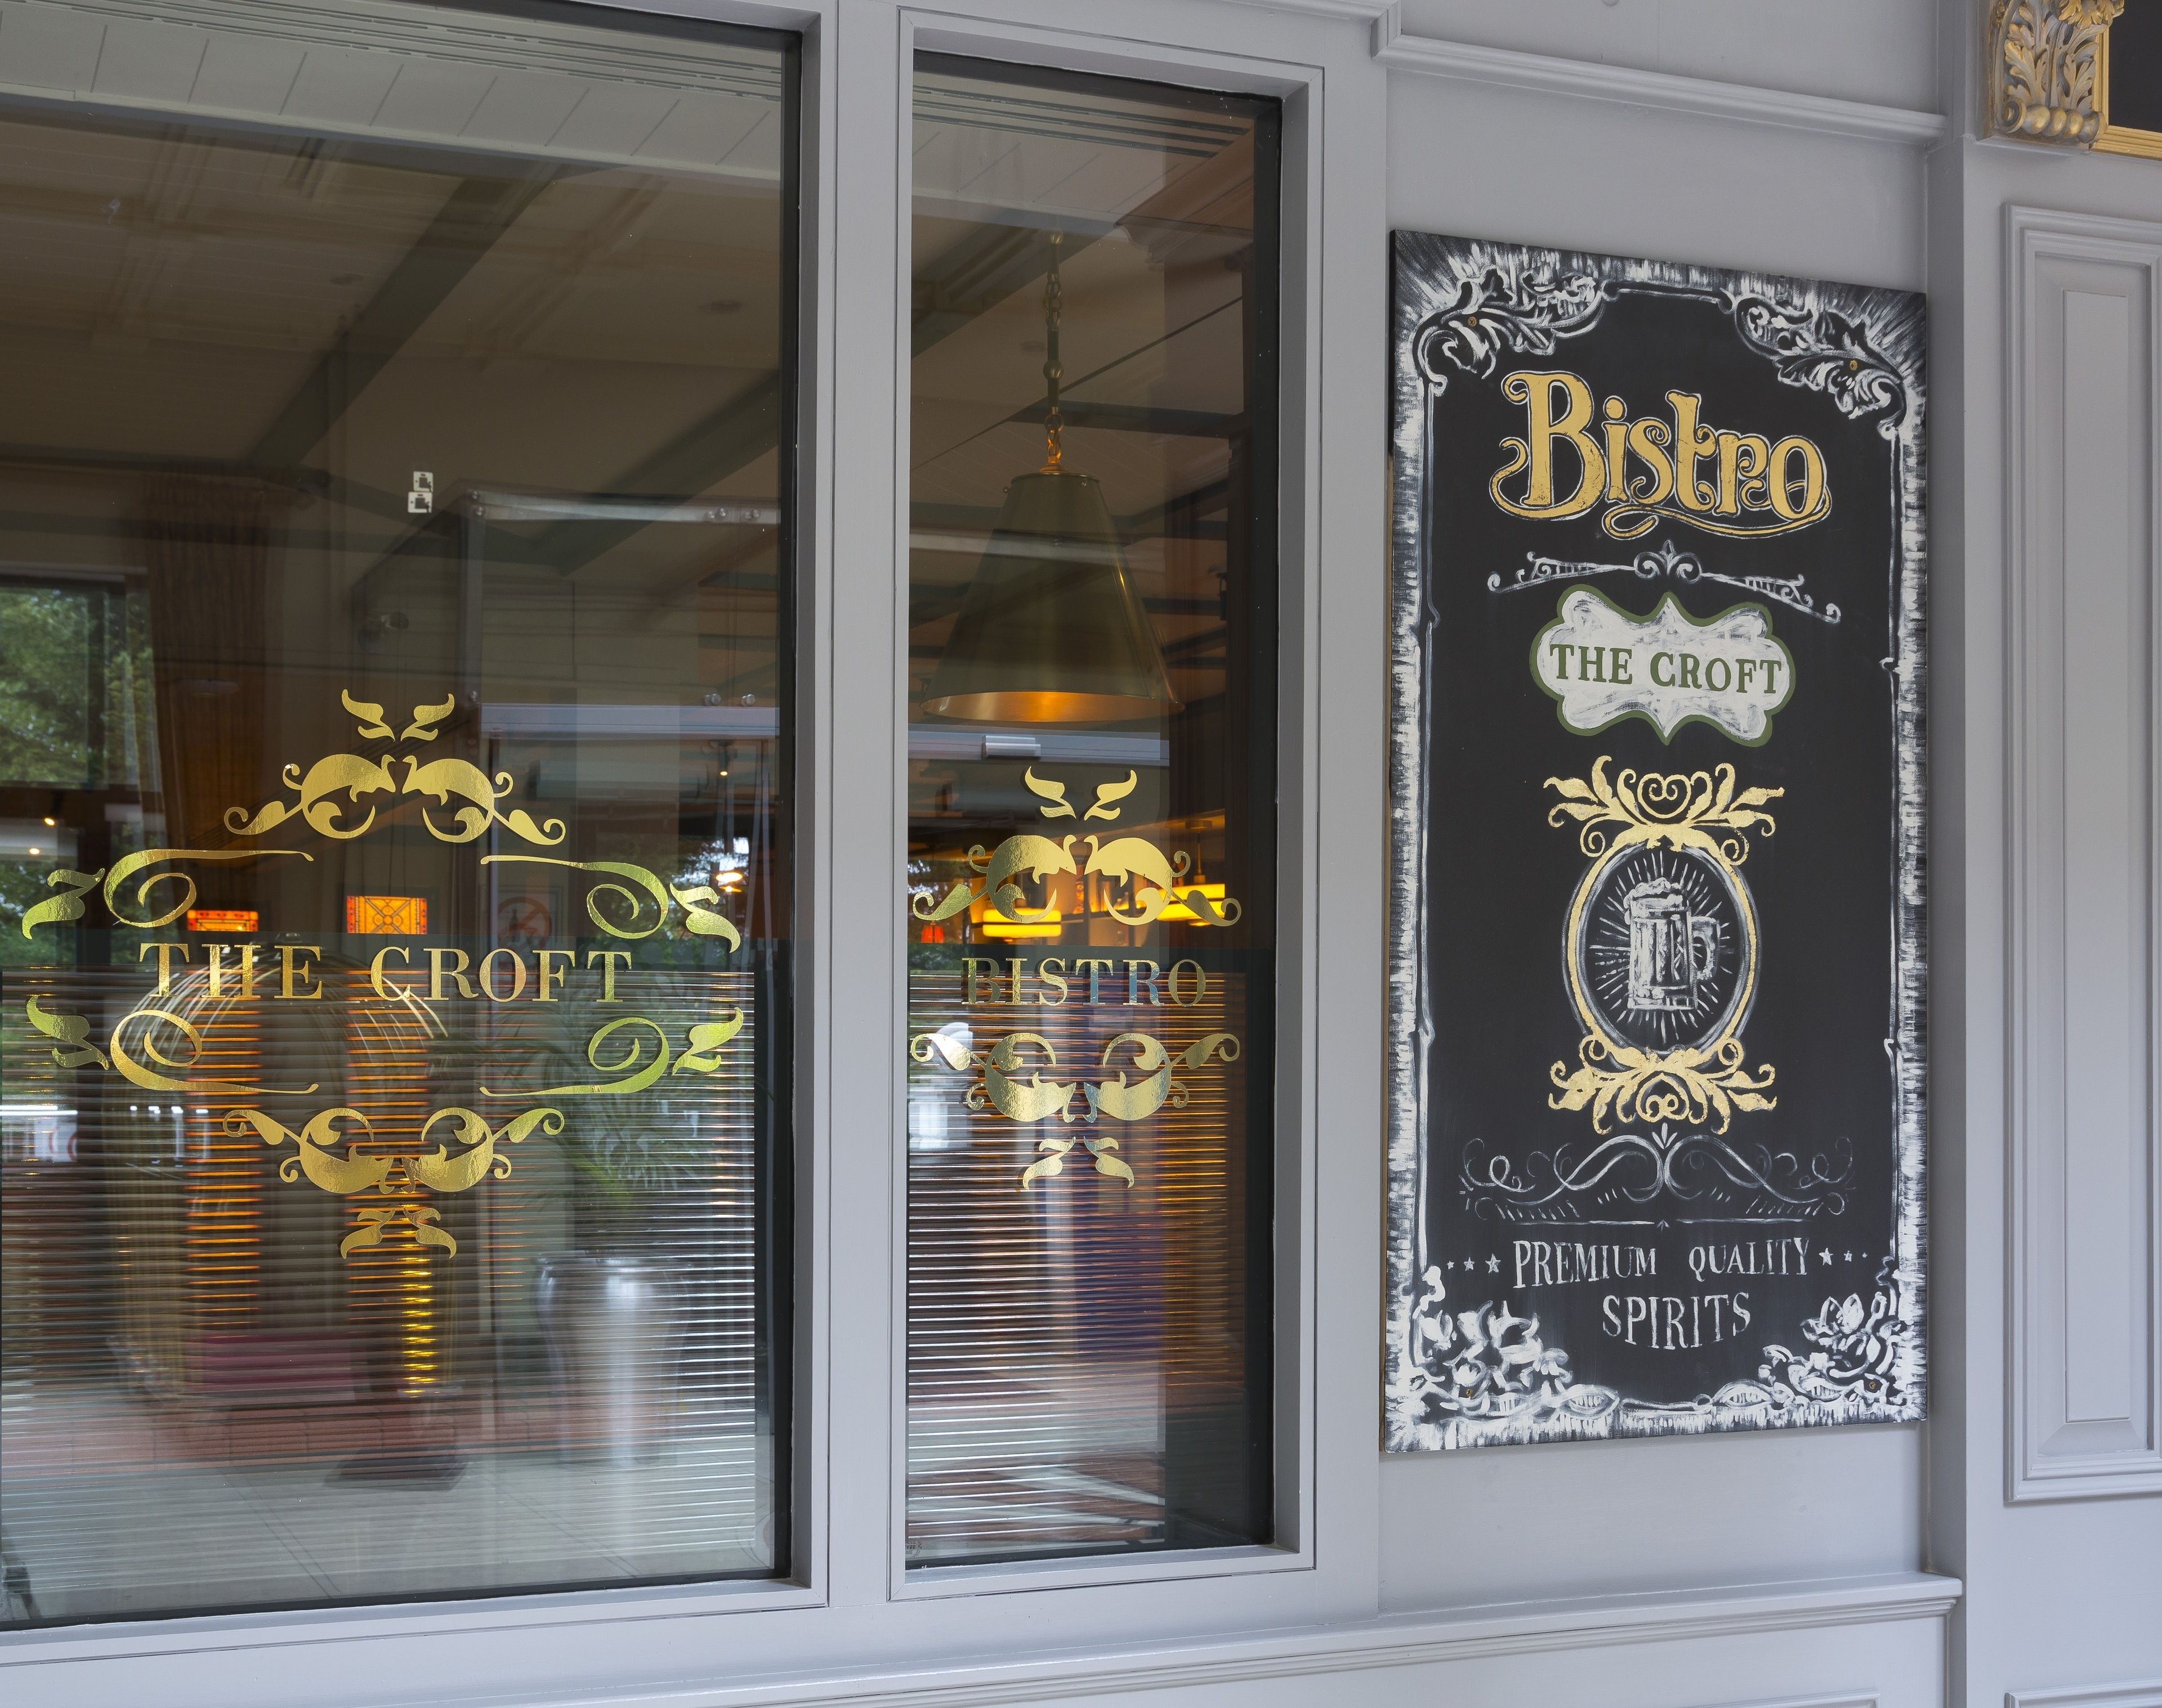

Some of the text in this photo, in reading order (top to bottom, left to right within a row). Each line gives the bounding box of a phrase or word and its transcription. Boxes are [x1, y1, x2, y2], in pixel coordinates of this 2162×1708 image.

[1489, 370, 1832, 540] Bistro
[1549, 643, 1783, 695] THE CROFT
[139, 942, 633, 1003] THE CROFT
[961, 957, 1206, 1007] BISTRO
[1512, 1237, 1810, 1289] PREMIUM QUALITY
[1602, 1291, 1752, 1351] SPIRITS
